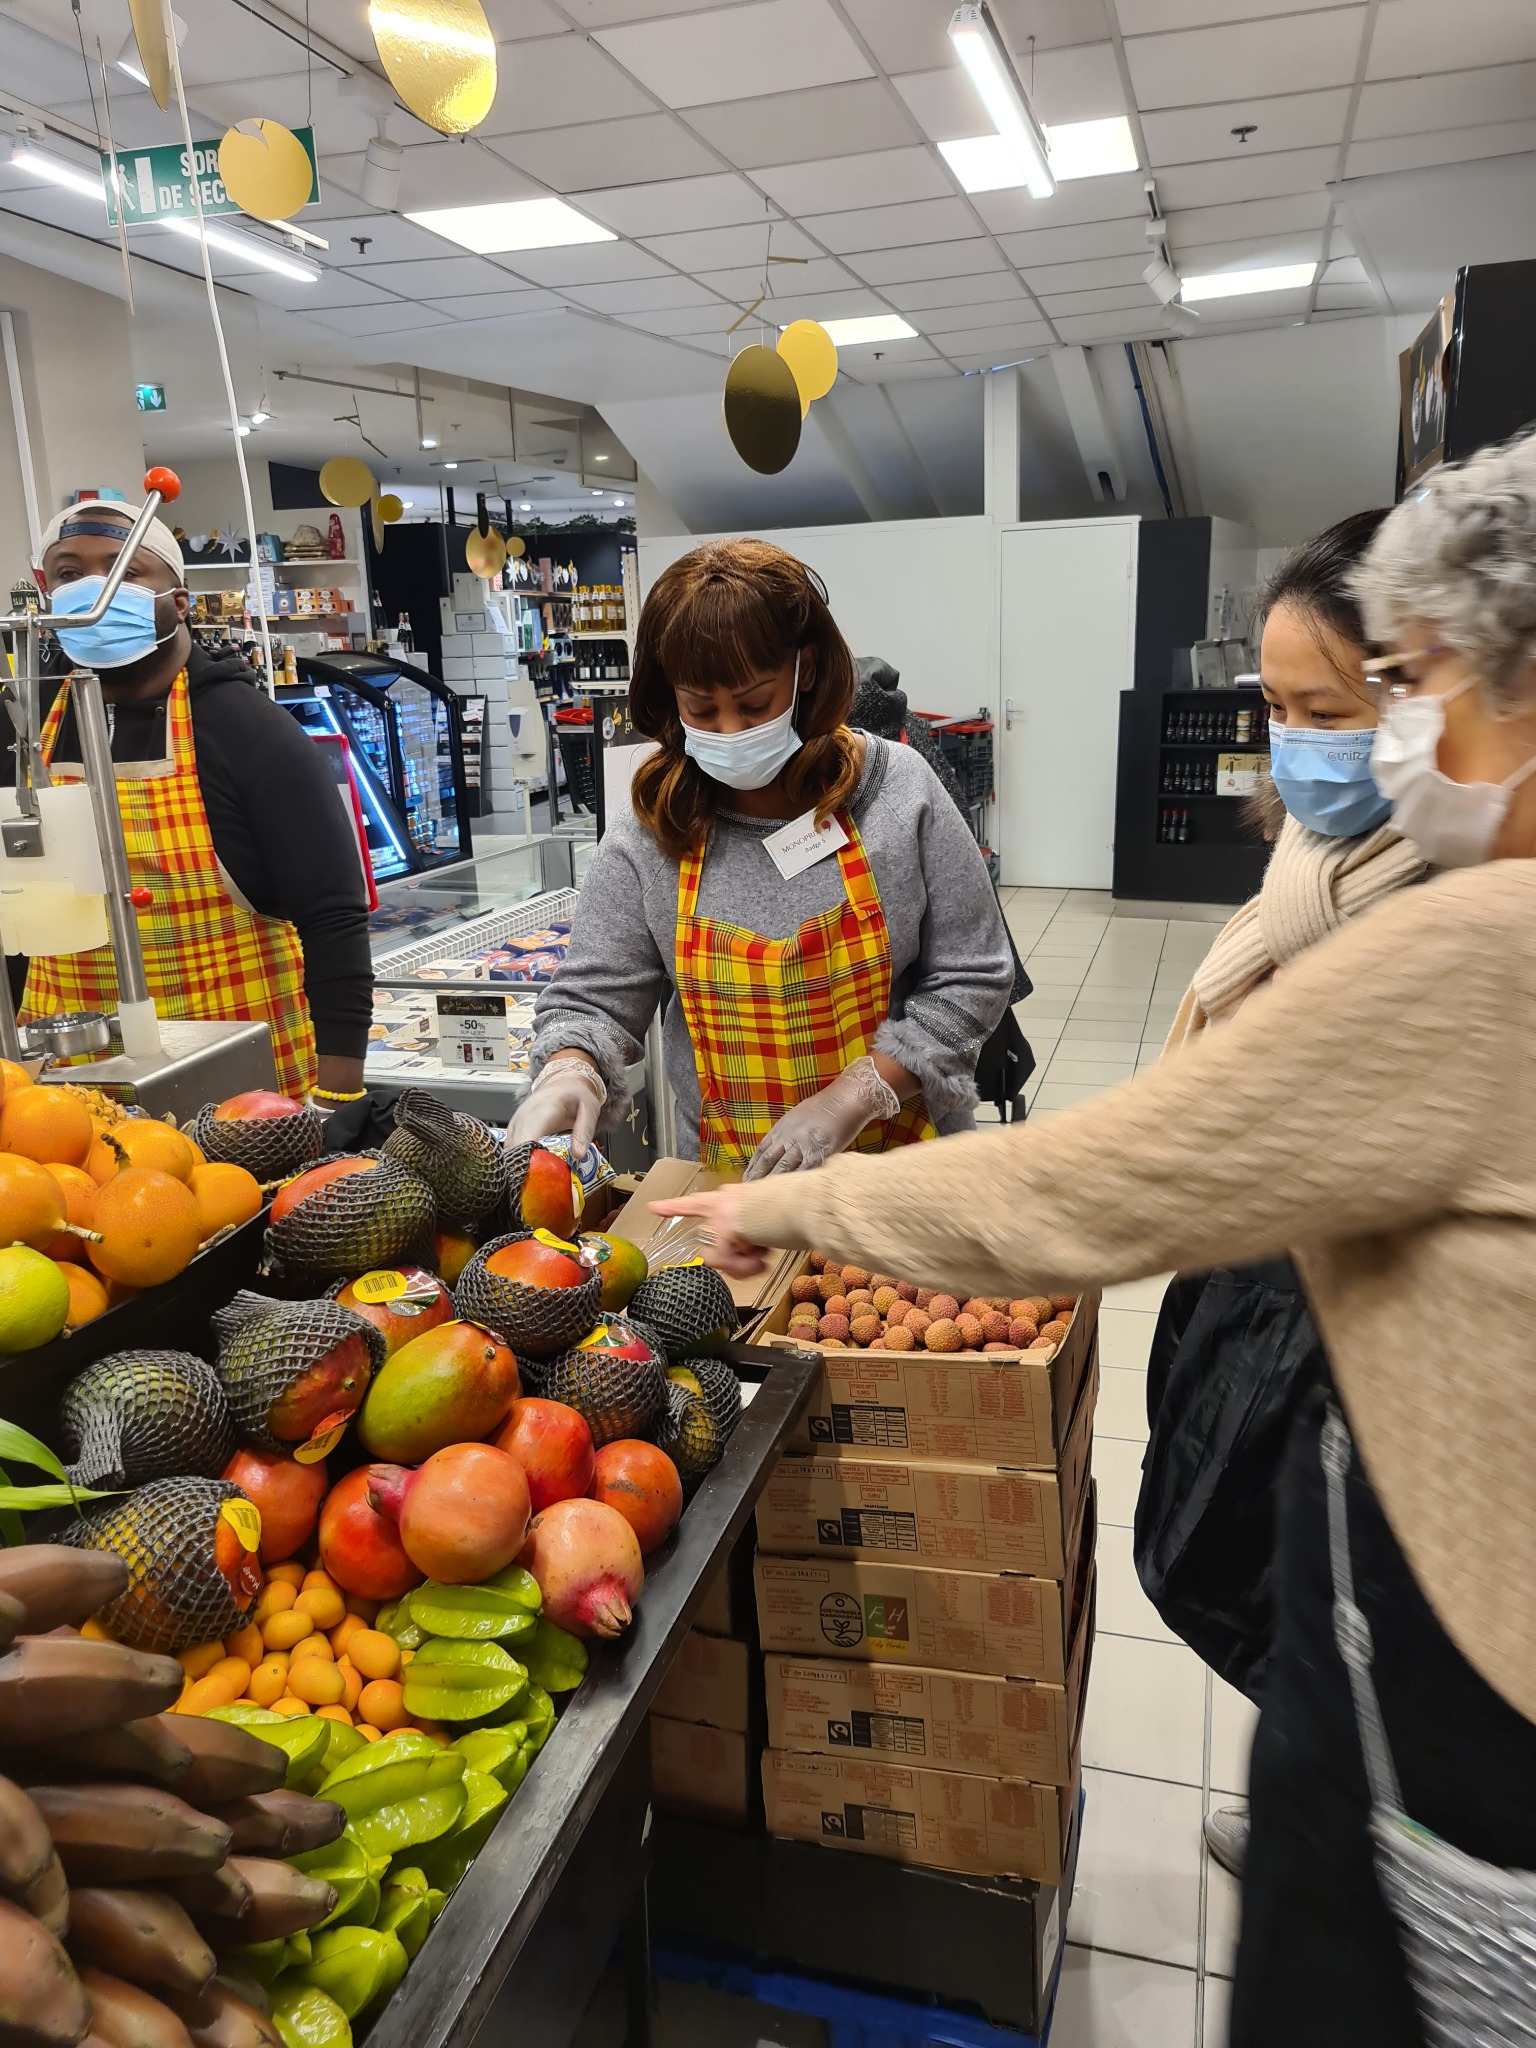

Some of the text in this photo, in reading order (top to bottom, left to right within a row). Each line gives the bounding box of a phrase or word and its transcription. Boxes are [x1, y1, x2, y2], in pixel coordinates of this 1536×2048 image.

[180, 150, 220, 178] SOR
[158, 179, 234, 210] DE SEC
[781, 831, 818, 854] MONOPRI
[888, 1608, 905, 1622] H
